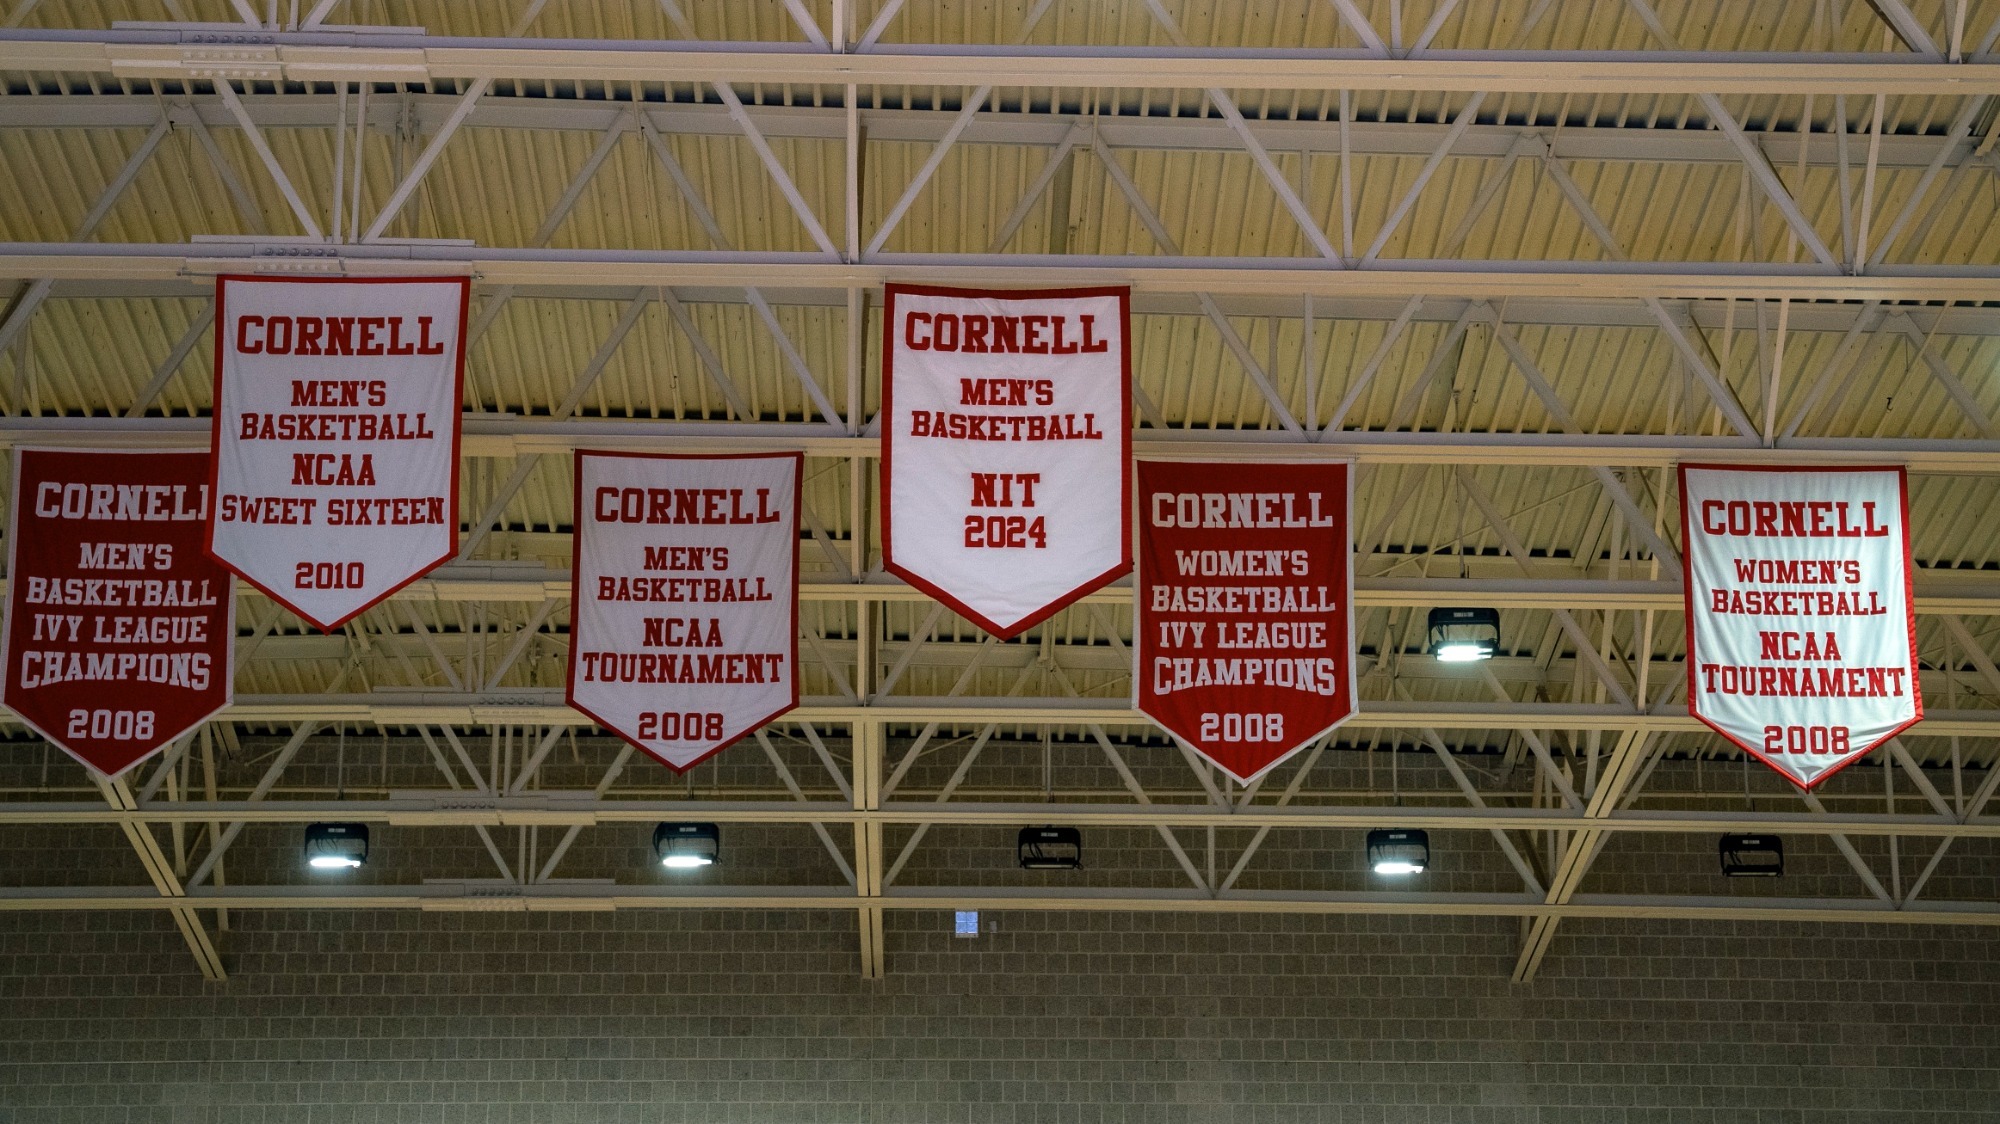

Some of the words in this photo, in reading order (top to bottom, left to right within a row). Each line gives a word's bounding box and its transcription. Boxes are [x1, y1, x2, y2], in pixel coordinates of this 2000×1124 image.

[236, 315, 444, 356] CORNELL
[905, 311, 1108, 355] CORNELL
[290, 380, 386, 407] MEN'S
[959, 377, 1054, 407] MEN'S
[239, 412, 434, 441] BASKETBALL
[910, 410, 1103, 442] BASKETBALL
[291, 453, 376, 486] NCAA
[595, 486, 780, 525] CORNELL
[970, 472, 1041, 508] NIT
[221, 494, 317, 525] SWEET
[327, 496, 445, 526] SIXTEEN
[1151, 492, 1334, 529] CORNELL
[1701, 499, 1889, 537] CORNELL
[964, 515, 1047, 549] 2024
[77, 542, 173, 571] MEN'S
[643, 546, 729, 571] MEN'S
[1174, 549, 1309, 577] WOMEN'S
[1734, 558, 1860, 584] WOMEN'S
[25, 575, 217, 608] BASKETBALL
[295, 562, 365, 590] 2010
[597, 575, 773, 603] BASKETBALL
[1151, 584, 1336, 613] BASKETBALL
[1711, 589, 1887, 616] BASKETBALL
[32, 613, 84, 643] IVY
[92, 615, 208, 644] LEAGUE
[642, 617, 724, 648] NCAA
[1159, 621, 1207, 649] IVY
[1217, 621, 1327, 649] LEAGUE
[1759, 631, 1841, 661] NCAA
[20, 650, 212, 691] CHAMPIONS
[582, 652, 784, 684] TOURNAMENT
[1153, 656, 1336, 696] CHAMPIONS
[1701, 663, 1905, 697] TOURNAMENT
[67, 708, 156, 741] 2008
[638, 712, 724, 741] 2008
[1200, 712, 1284, 743] 2008
[1764, 725, 1850, 755] 2008
